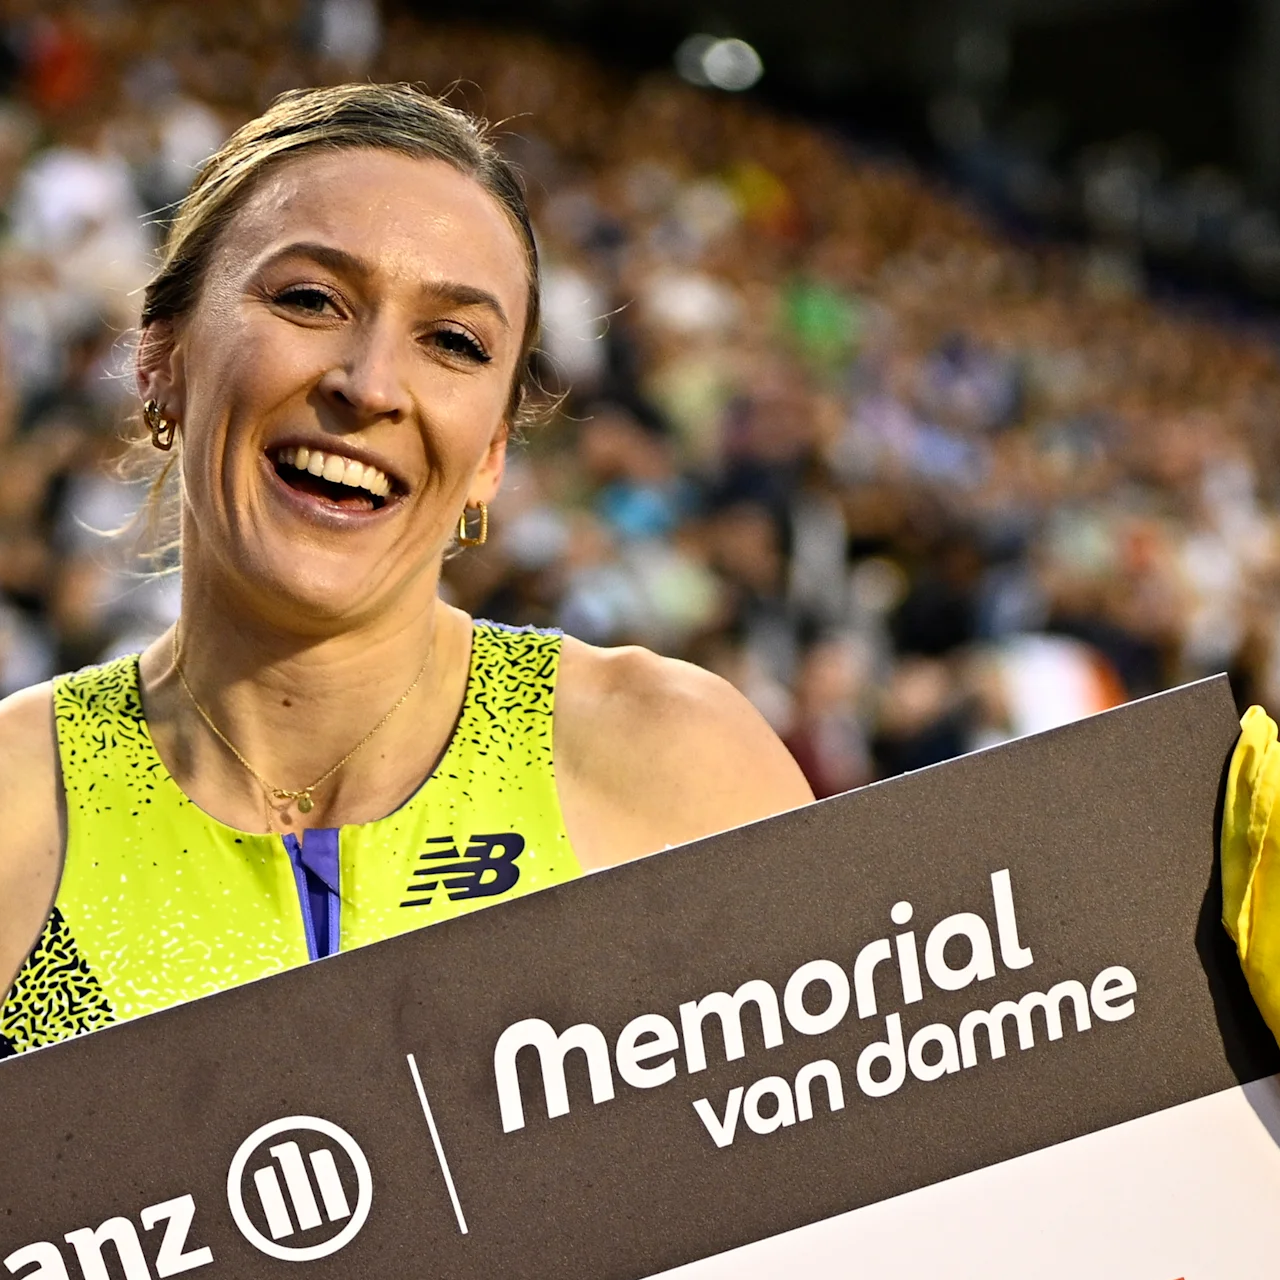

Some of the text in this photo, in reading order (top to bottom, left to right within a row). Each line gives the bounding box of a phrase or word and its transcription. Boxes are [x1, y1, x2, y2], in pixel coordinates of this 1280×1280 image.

[400, 832, 525, 908] NB
[693, 966, 1137, 1148] van damme
